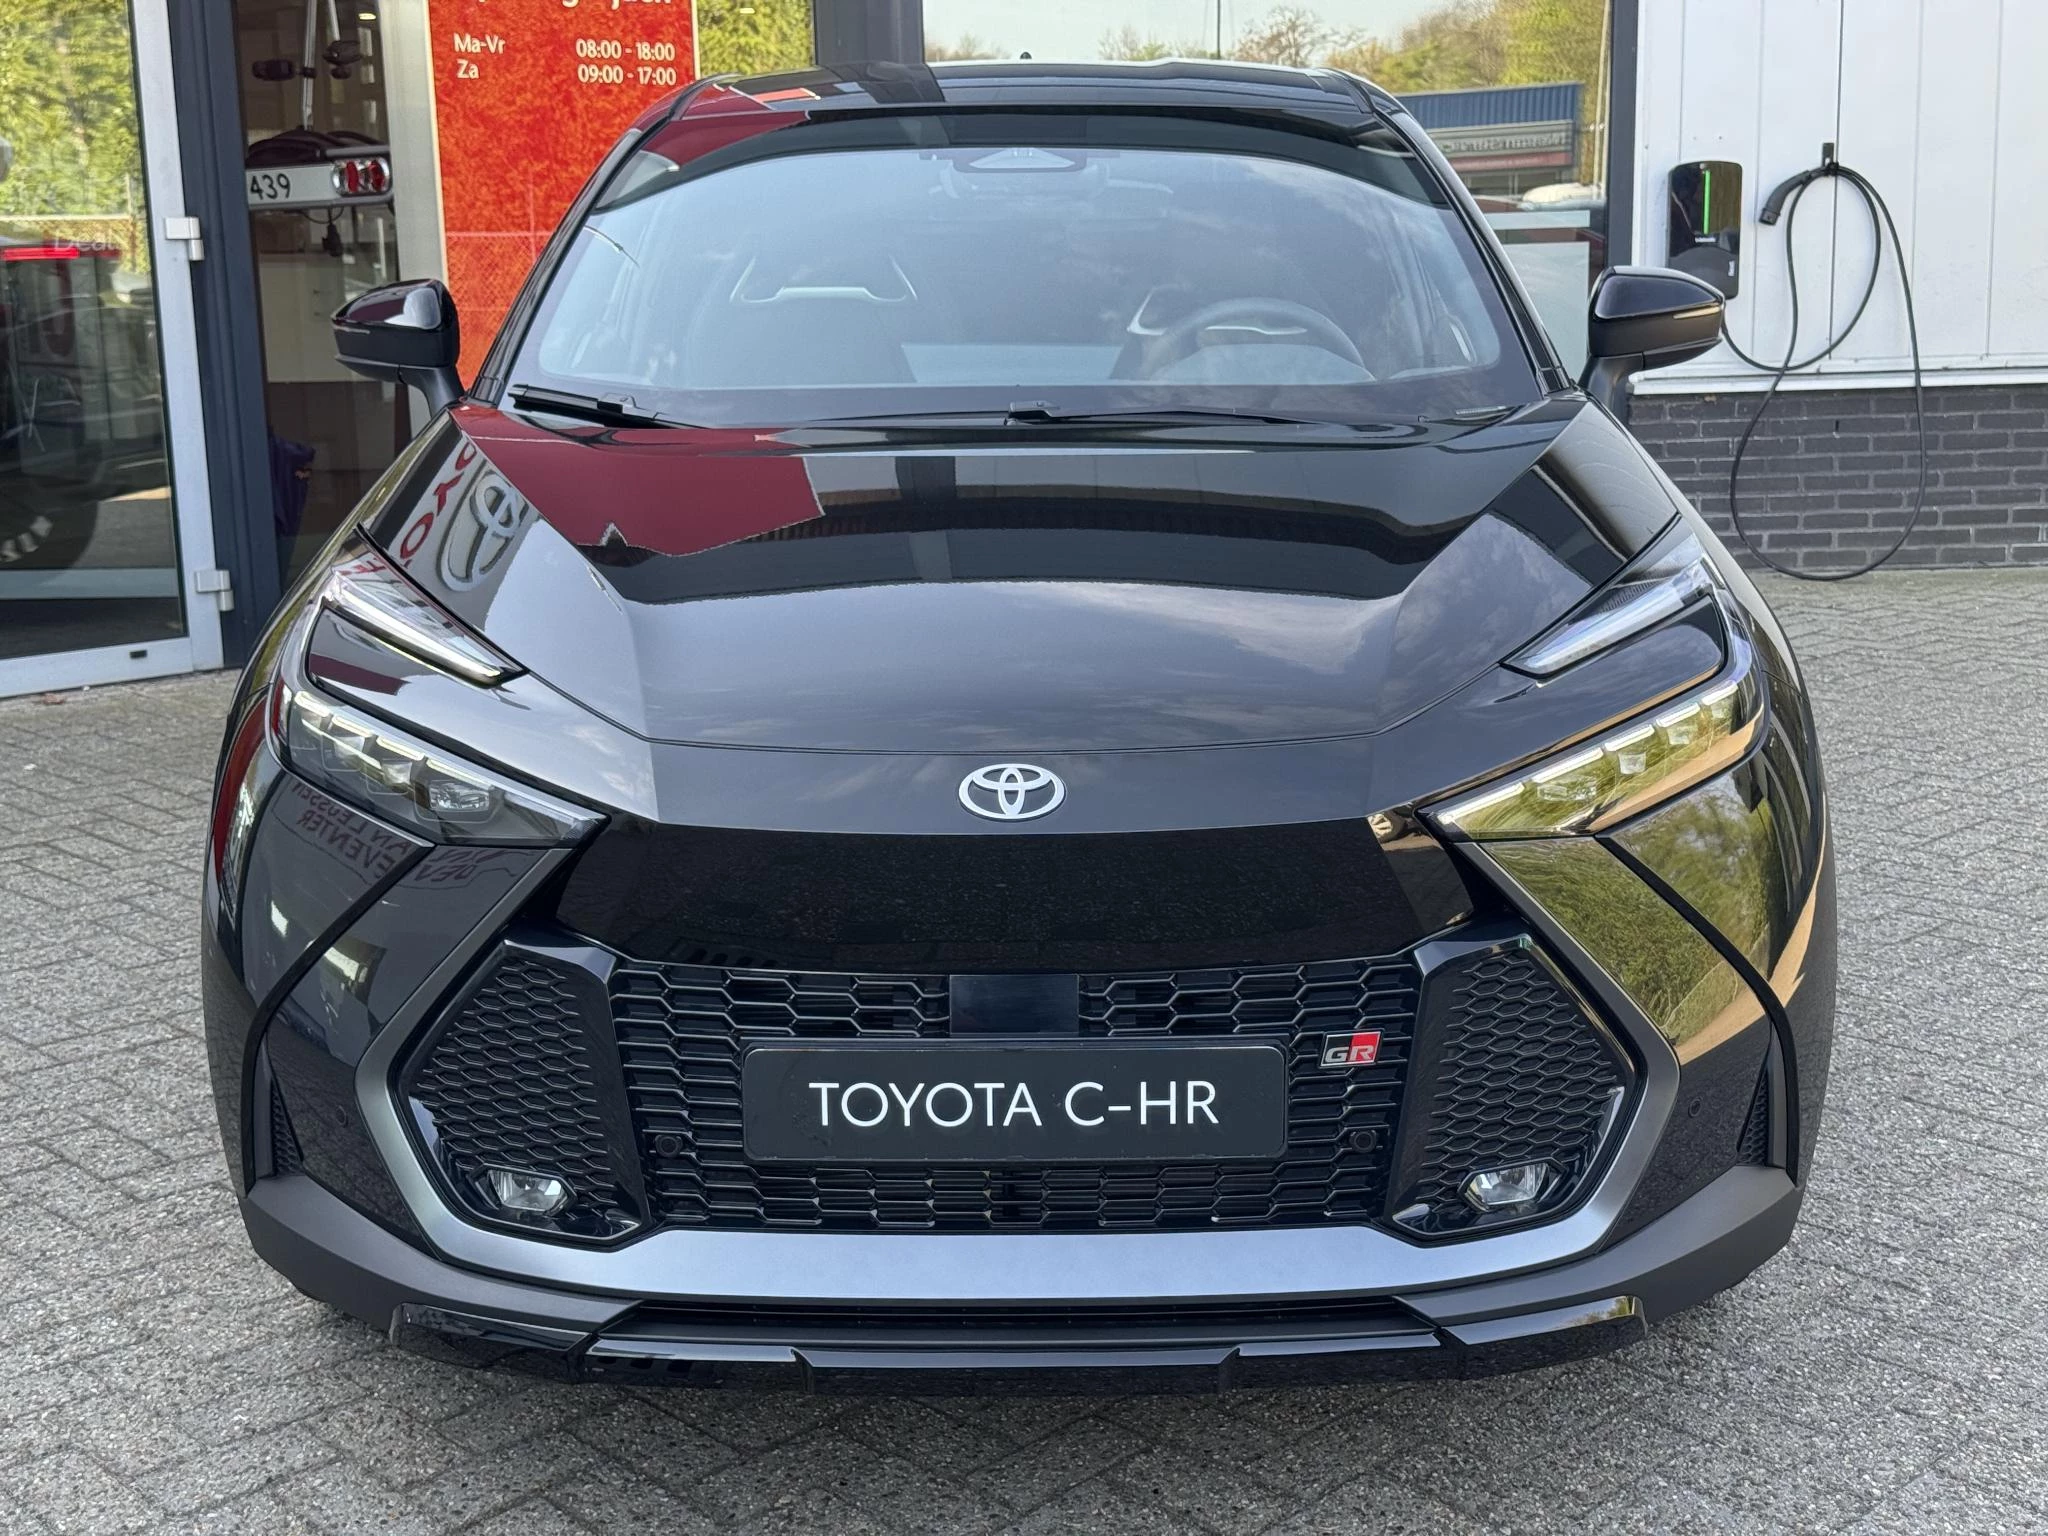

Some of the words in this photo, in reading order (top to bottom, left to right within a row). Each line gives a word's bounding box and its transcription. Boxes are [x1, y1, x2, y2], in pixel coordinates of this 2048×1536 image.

[453, 32, 506, 55] Ma-Vr
[575, 38, 622, 59] 08:00
[635, 41, 676, 62] 18:00
[456, 58, 480, 79] Za
[577, 63, 624, 84] 09:00
[637, 66, 677, 86] 17:00
[250, 173, 291, 200] 439
[1325, 1045, 1375, 1063] GR
[808, 1082, 1043, 1127] TOYOTA
[1064, 1080, 1220, 1127] C-HR
